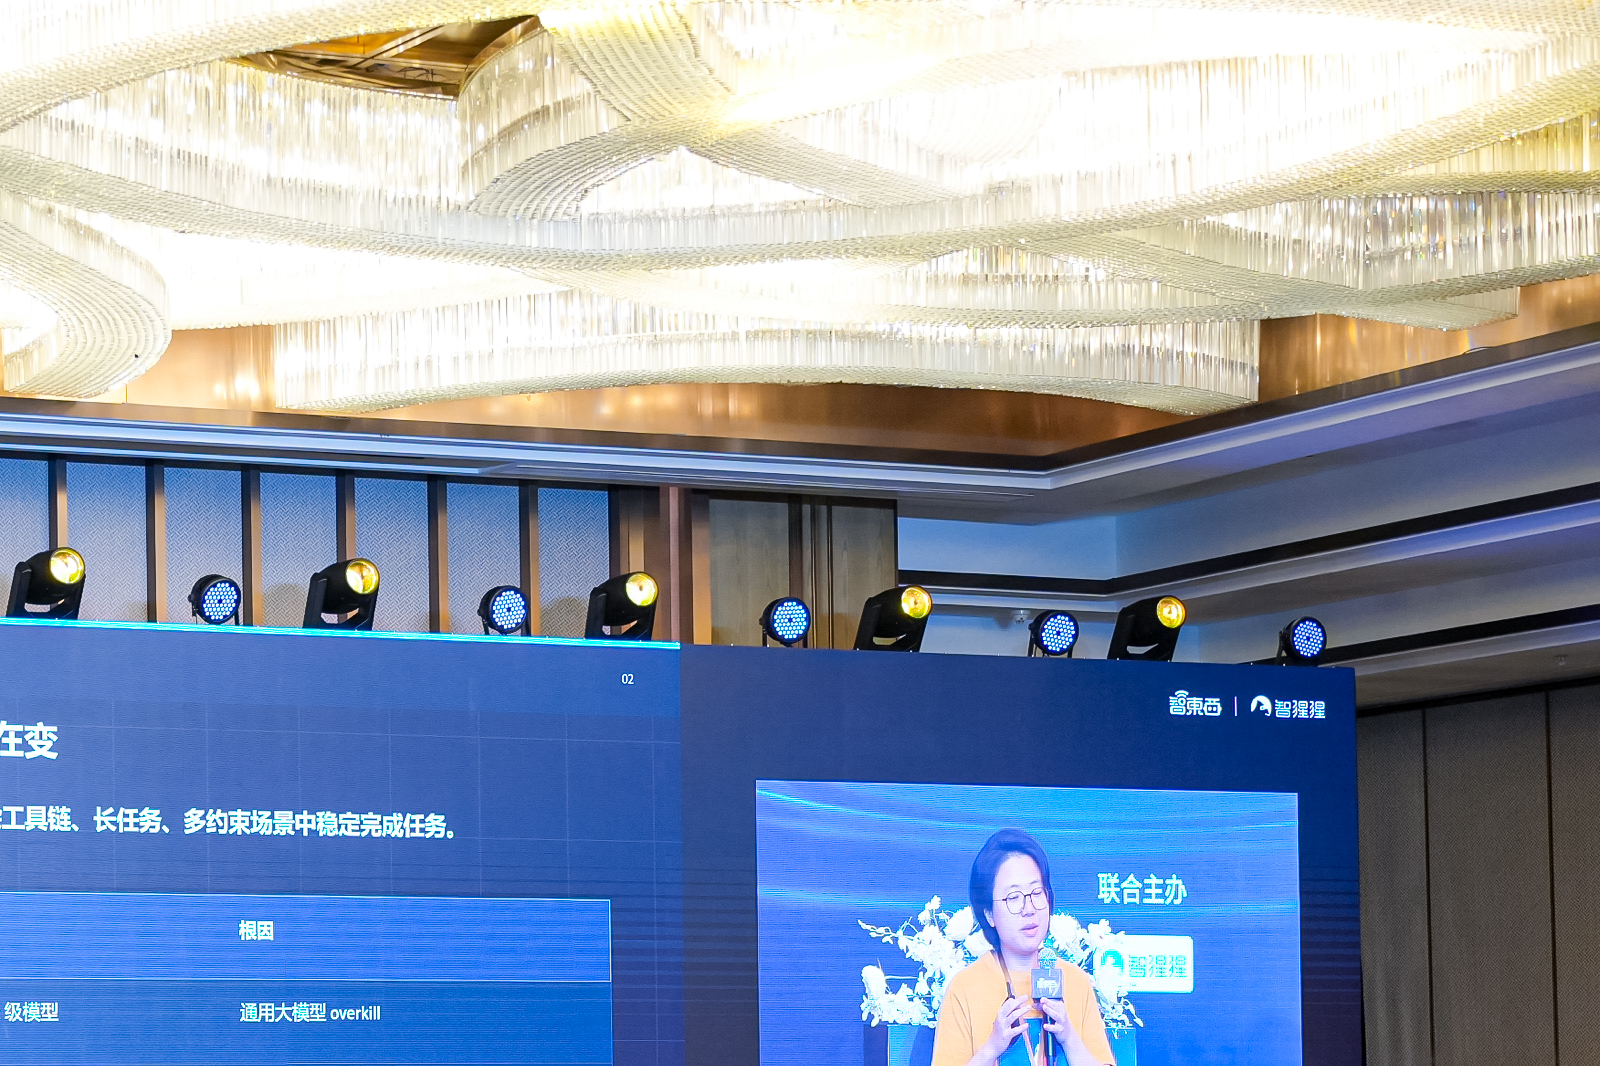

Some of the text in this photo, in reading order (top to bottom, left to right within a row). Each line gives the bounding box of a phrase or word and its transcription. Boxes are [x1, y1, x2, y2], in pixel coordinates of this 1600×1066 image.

[621, 673, 635, 685] 02
[1097, 872, 1188, 907] 联合主办
[238, 919, 274, 941] 根因
[3, 1001, 60, 1023] 级模型
[239, 1001, 381, 1023] 通用大模型 overkill
